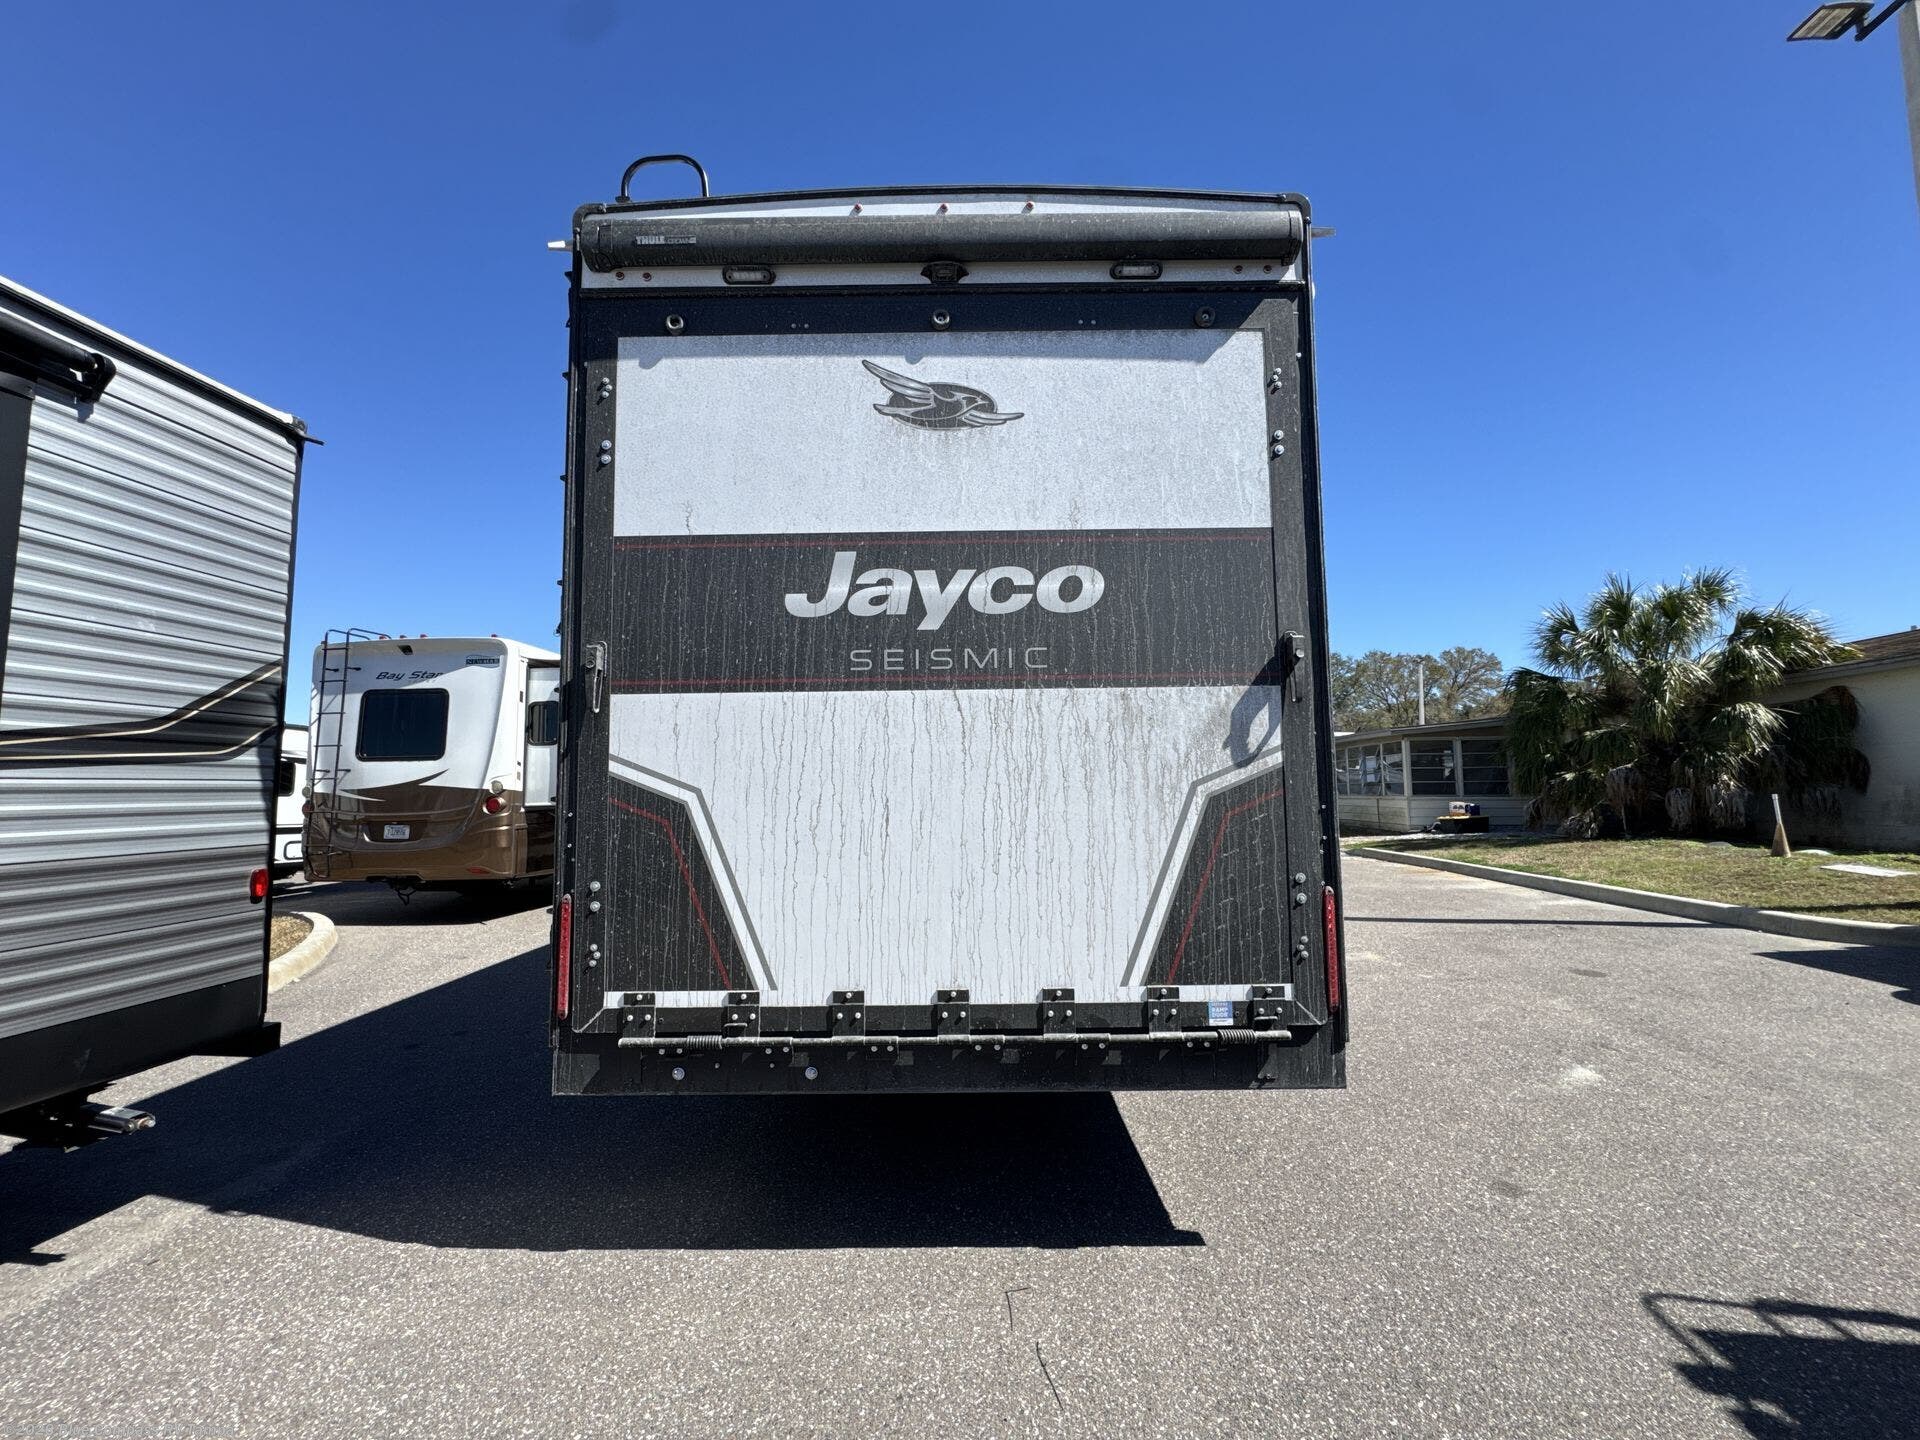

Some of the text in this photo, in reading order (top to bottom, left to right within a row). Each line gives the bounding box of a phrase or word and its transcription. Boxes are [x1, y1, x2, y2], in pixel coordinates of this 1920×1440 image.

[635, 235, 665, 245] THULE
[784, 551, 1105, 631] Jayco
[850, 646, 1049, 671] SEISMIC
[375, 670, 444, 681] Bay Star
